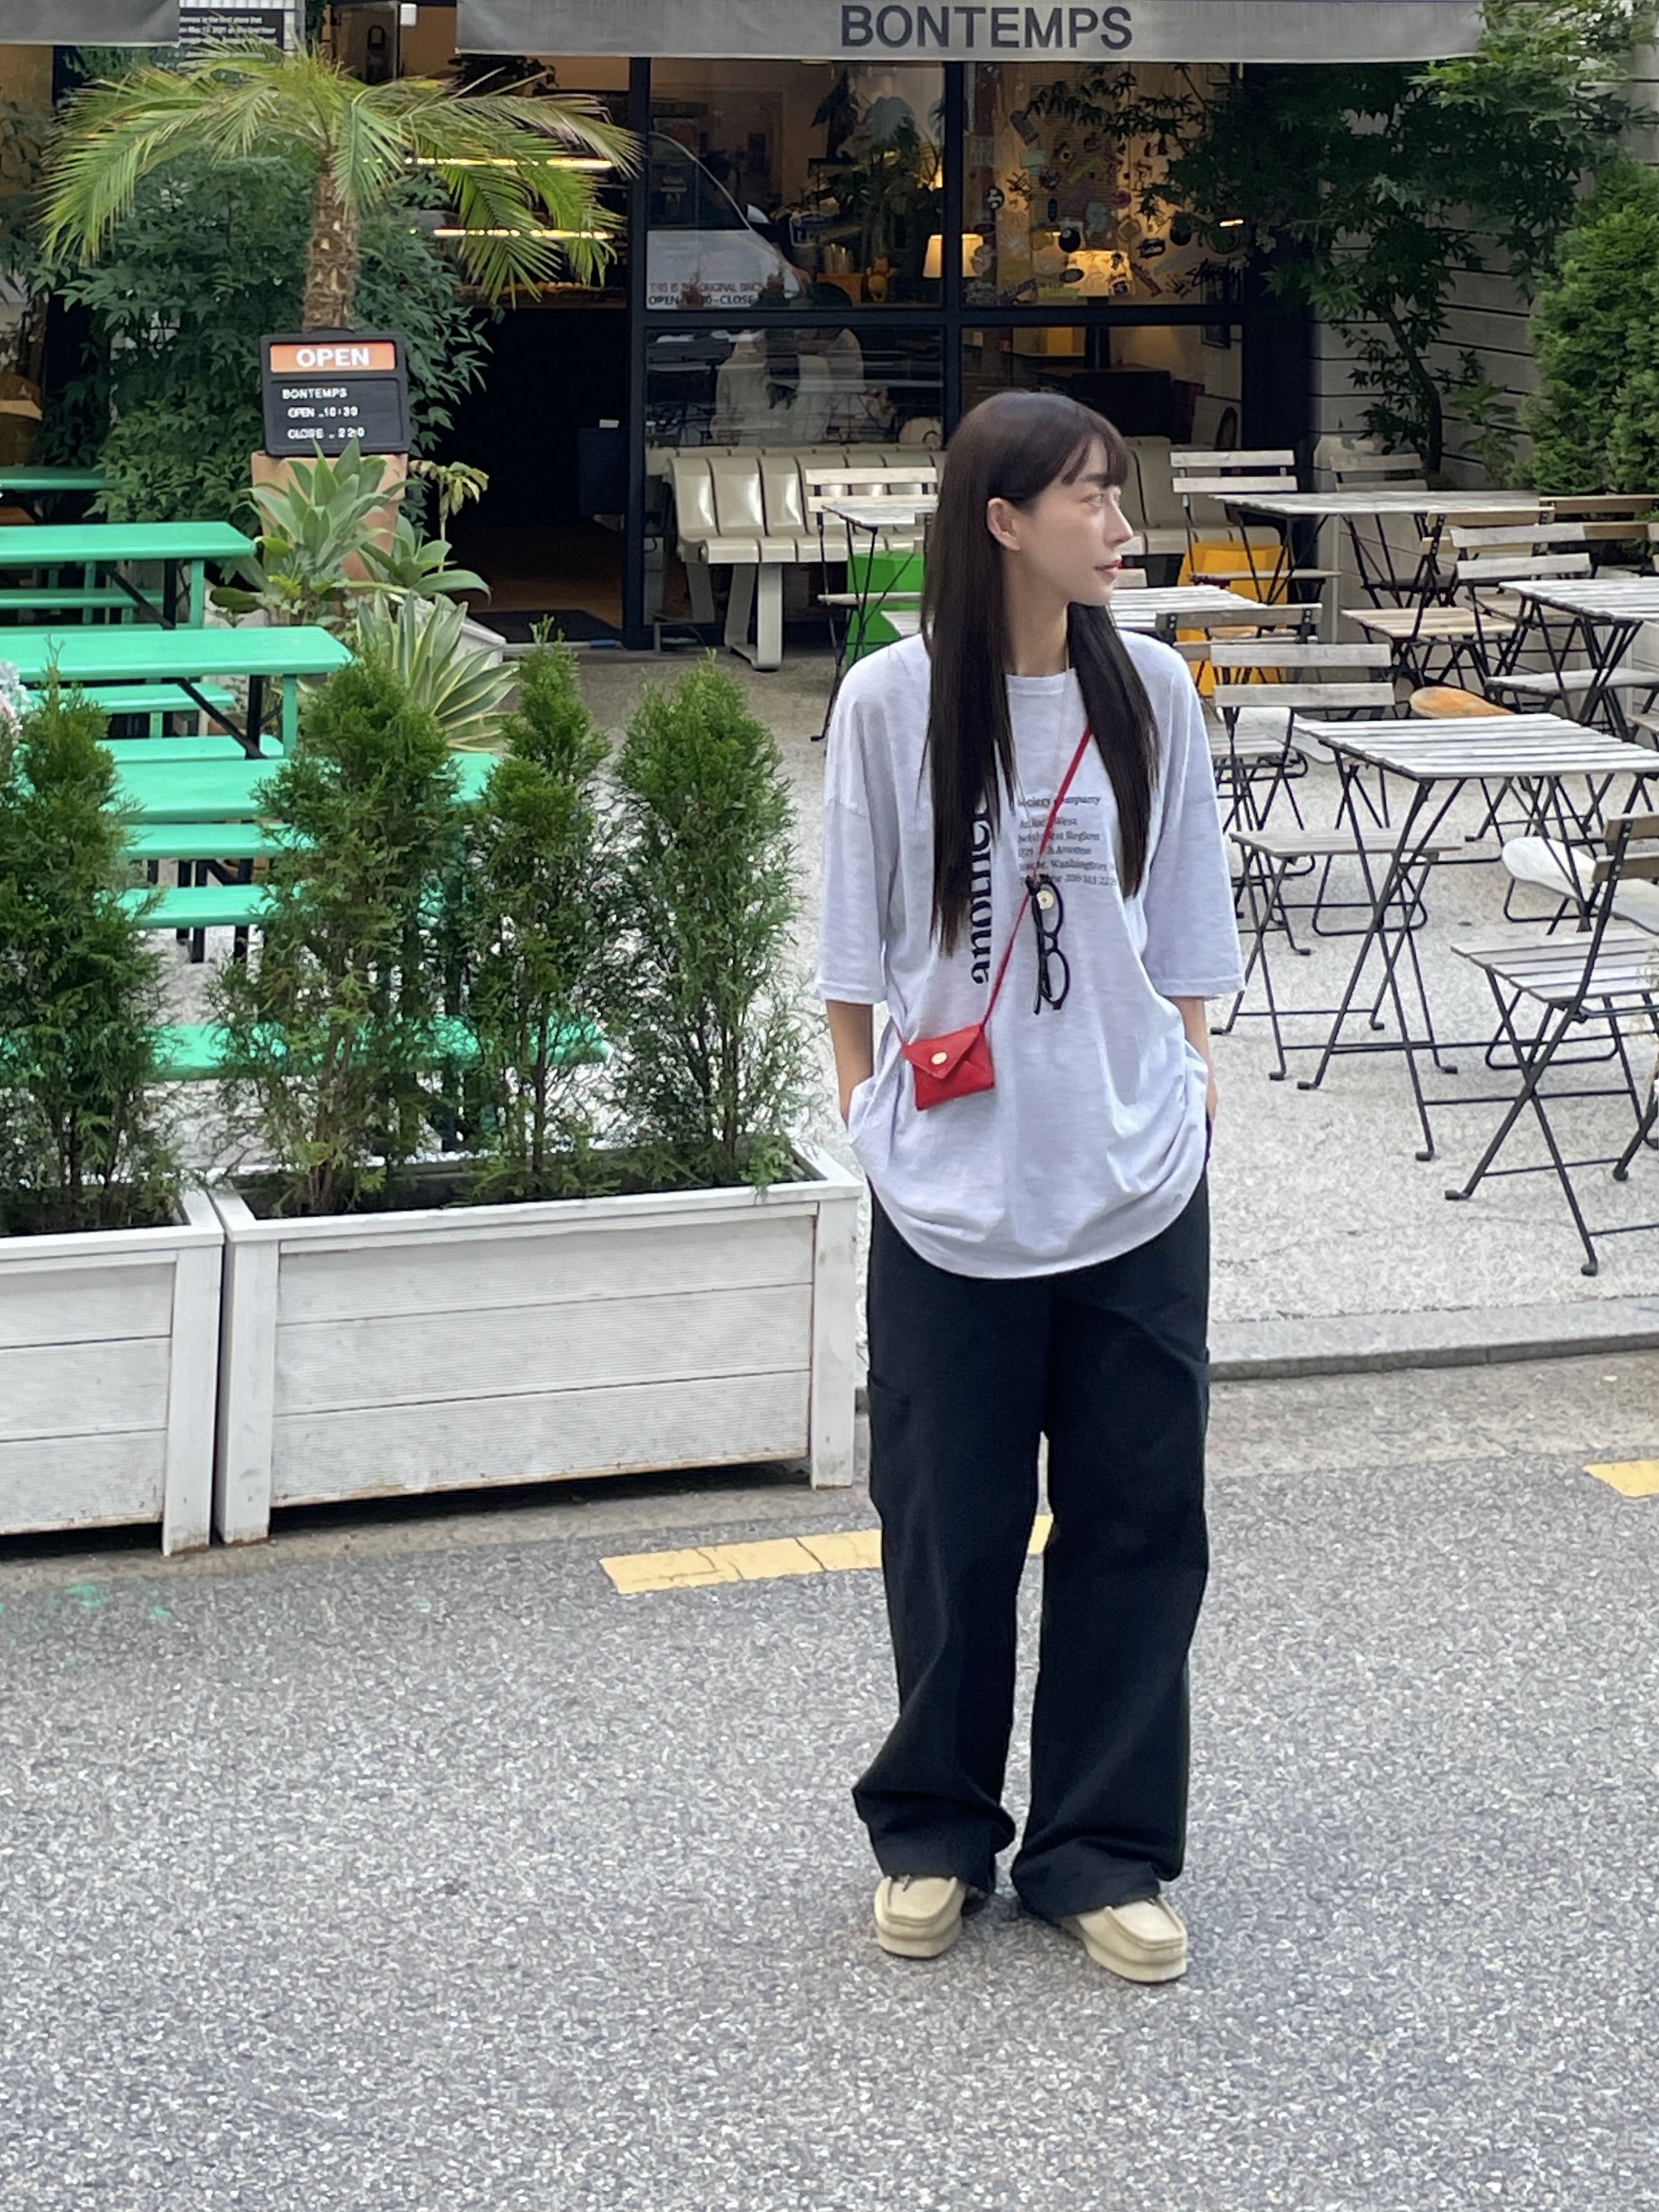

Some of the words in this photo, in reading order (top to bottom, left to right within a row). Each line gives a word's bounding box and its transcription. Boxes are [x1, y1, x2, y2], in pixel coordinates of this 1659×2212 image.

[841, 4, 1133, 50] BONTEMPS
[649, 295, 679, 305] OPEN
[296, 347, 370, 368] OPEN
[282, 387, 348, 400] BONTEMPS
[287, 406, 316, 419] OPEN
